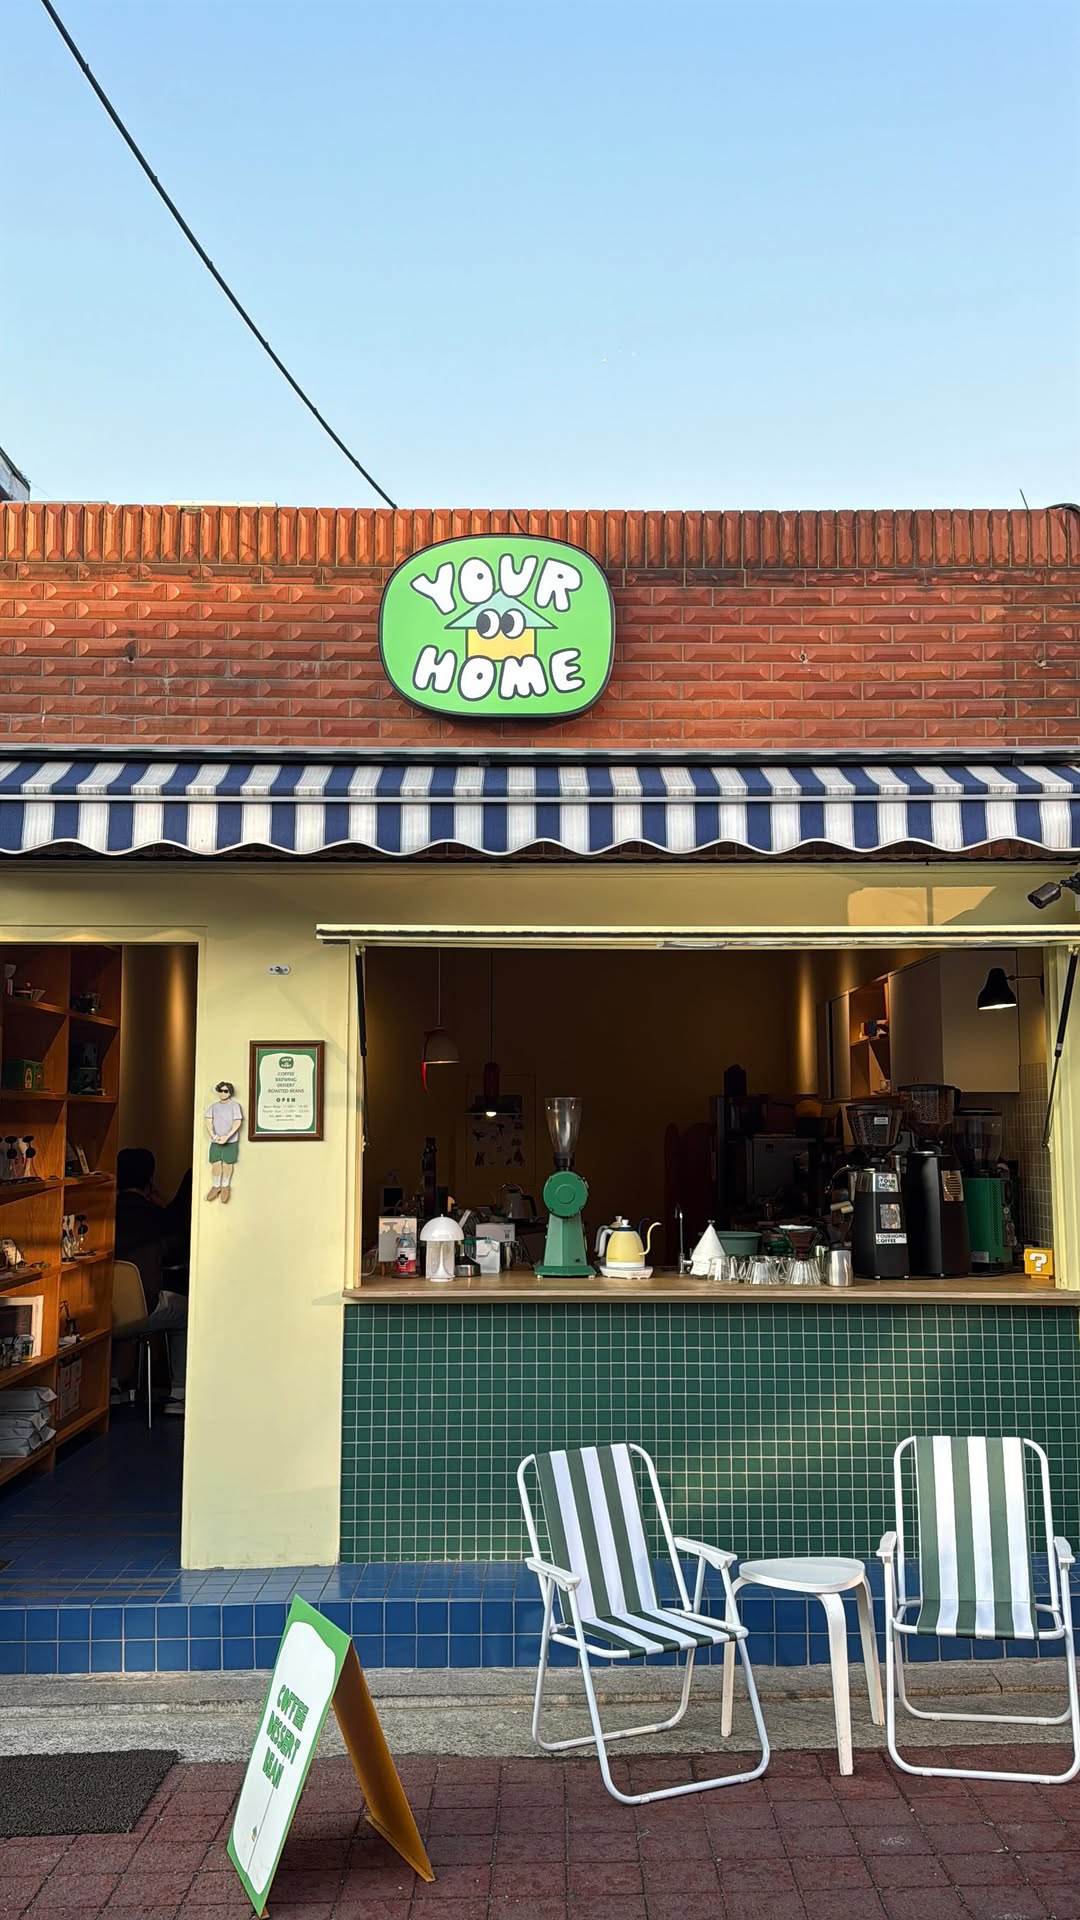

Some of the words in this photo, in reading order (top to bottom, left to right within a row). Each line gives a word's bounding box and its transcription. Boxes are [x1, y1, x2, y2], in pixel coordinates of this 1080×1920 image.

[410, 553, 583, 615] YOUR
[412, 644, 585, 702] HOME
[1030, 1253, 1048, 1272] ?
[276, 1683, 310, 1733] COFFEE
[266, 1709, 302, 1765] DESSERT
[262, 1746, 285, 1790] BEAN
